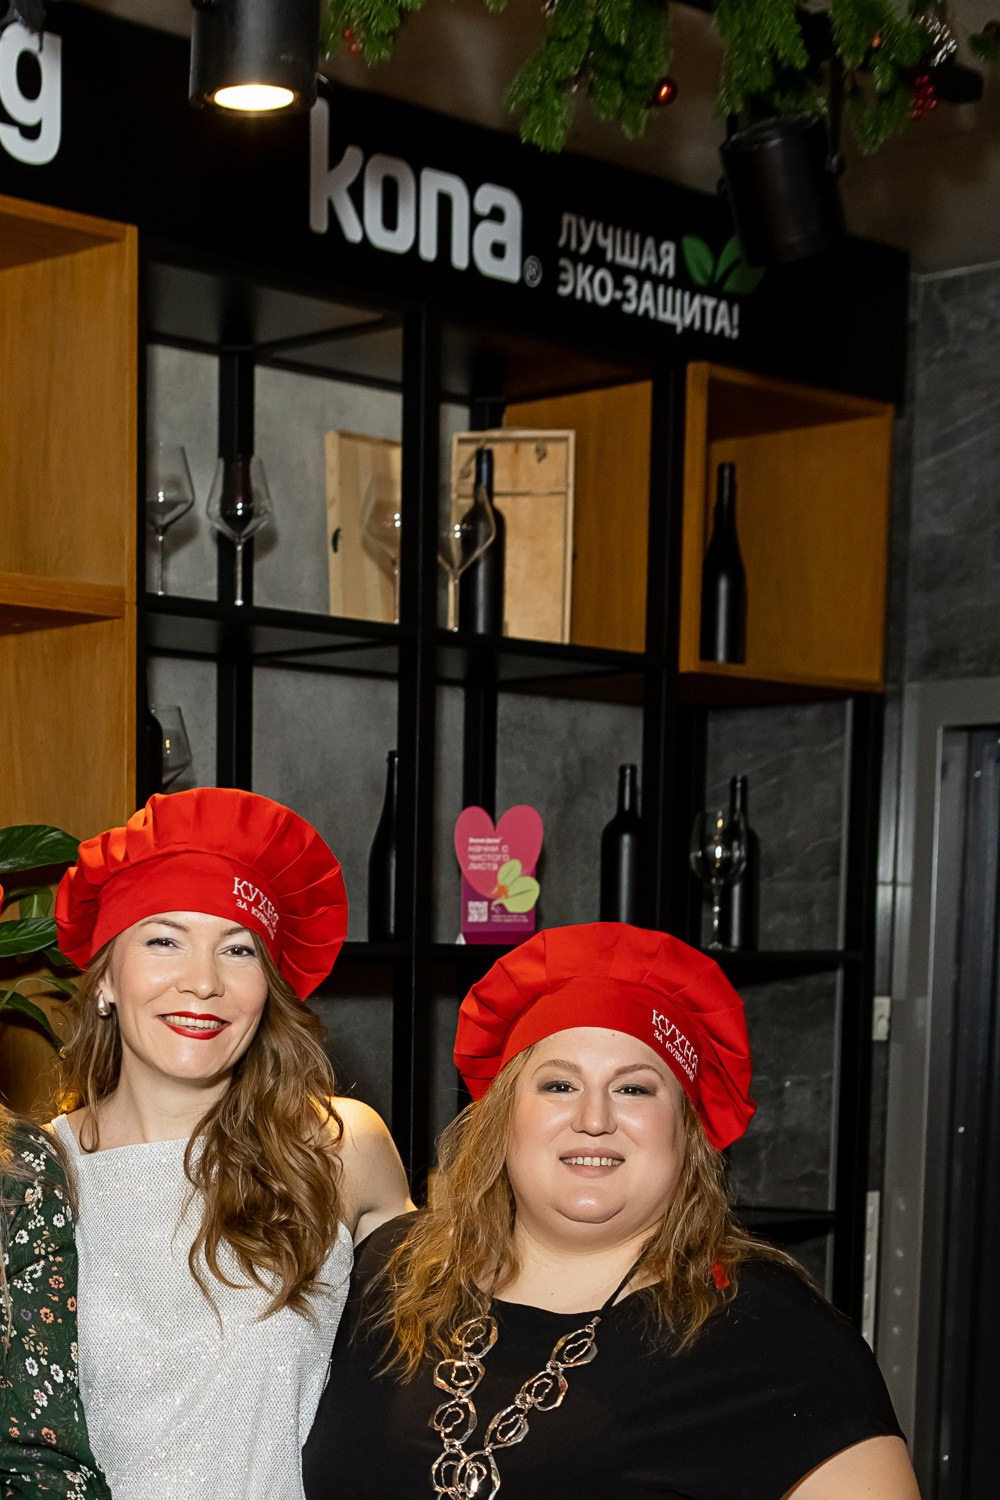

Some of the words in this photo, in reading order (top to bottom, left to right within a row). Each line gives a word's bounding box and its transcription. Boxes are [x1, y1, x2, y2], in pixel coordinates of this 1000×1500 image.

[557, 211, 677, 279] ЛУЧШАЯ
[556, 260, 741, 340] ЭКО-ЗАЩИТА!
[651, 1008, 699, 1077] КУХНЯ
